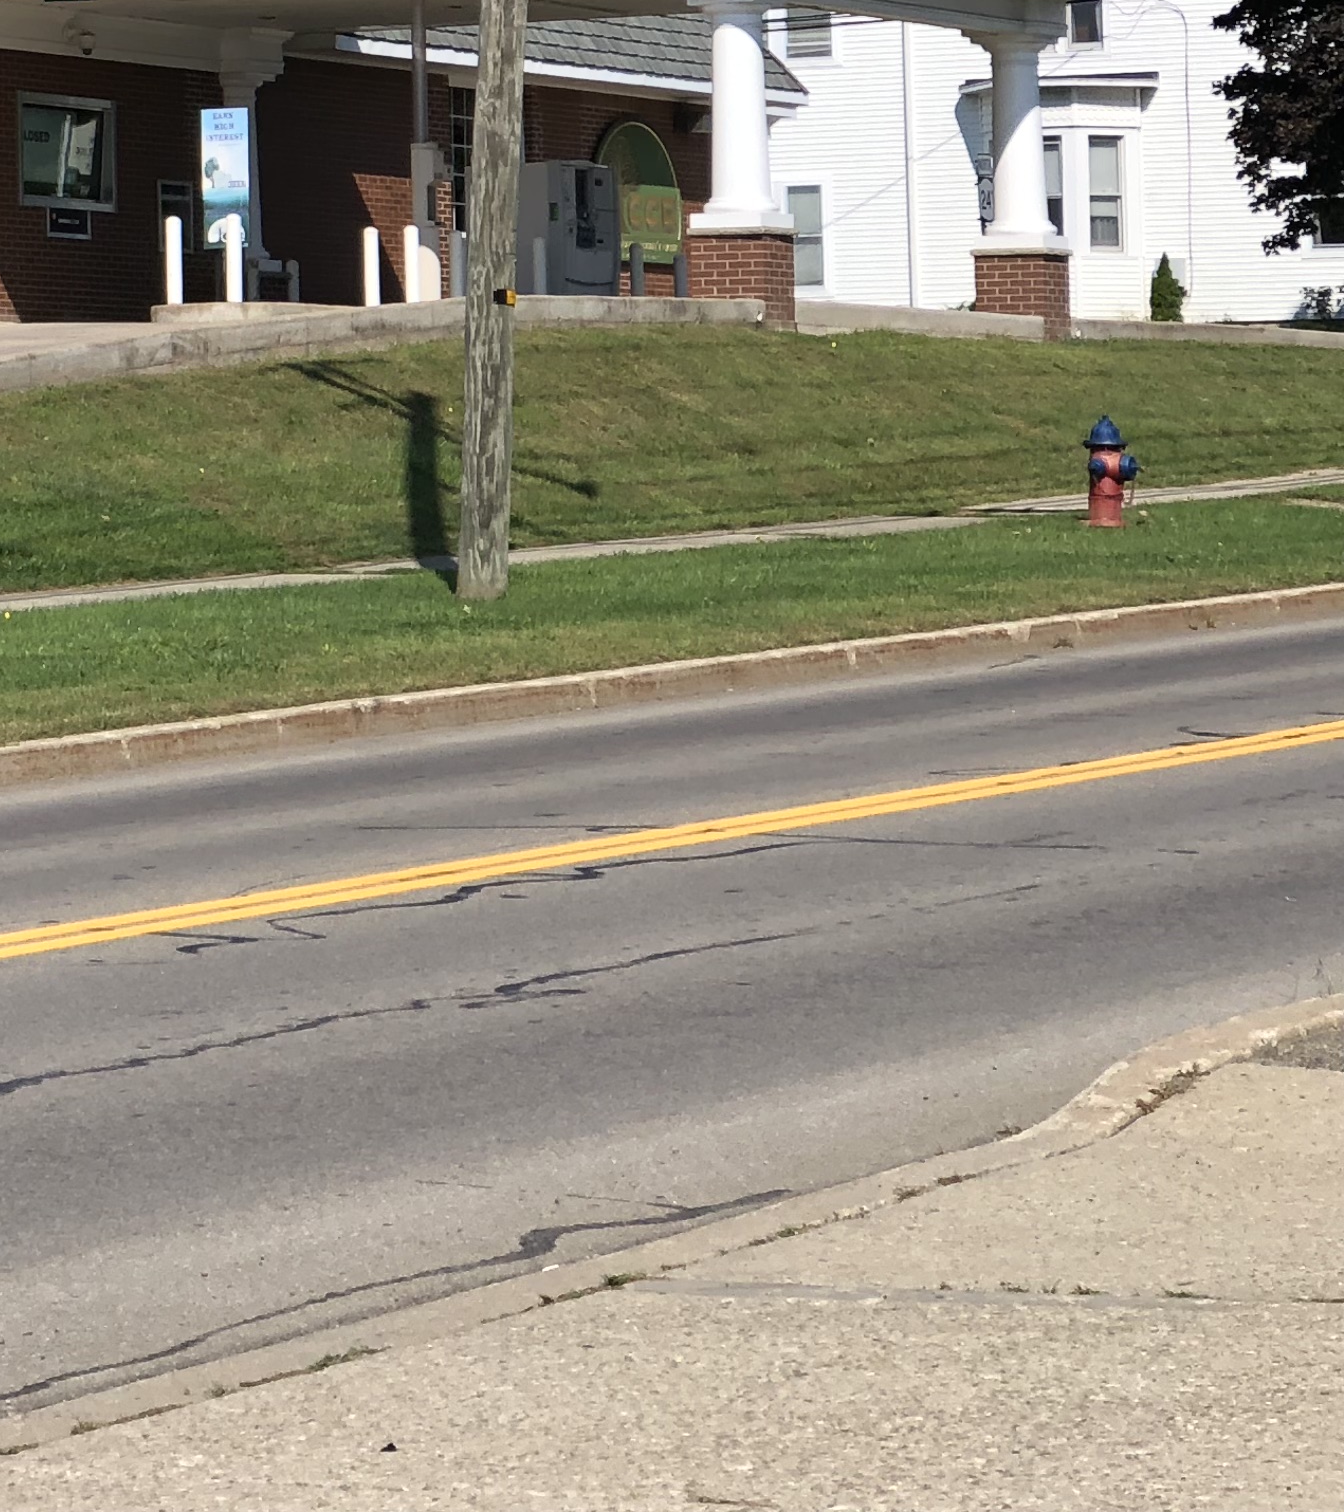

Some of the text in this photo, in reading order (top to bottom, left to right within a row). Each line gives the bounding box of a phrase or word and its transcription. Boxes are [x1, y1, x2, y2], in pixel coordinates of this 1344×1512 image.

[213, 112, 233, 121] EARN
[214, 122, 234, 130] HIGH
[23, 130, 50, 143] LOSED
[206, 133, 244, 141] INTEREST
